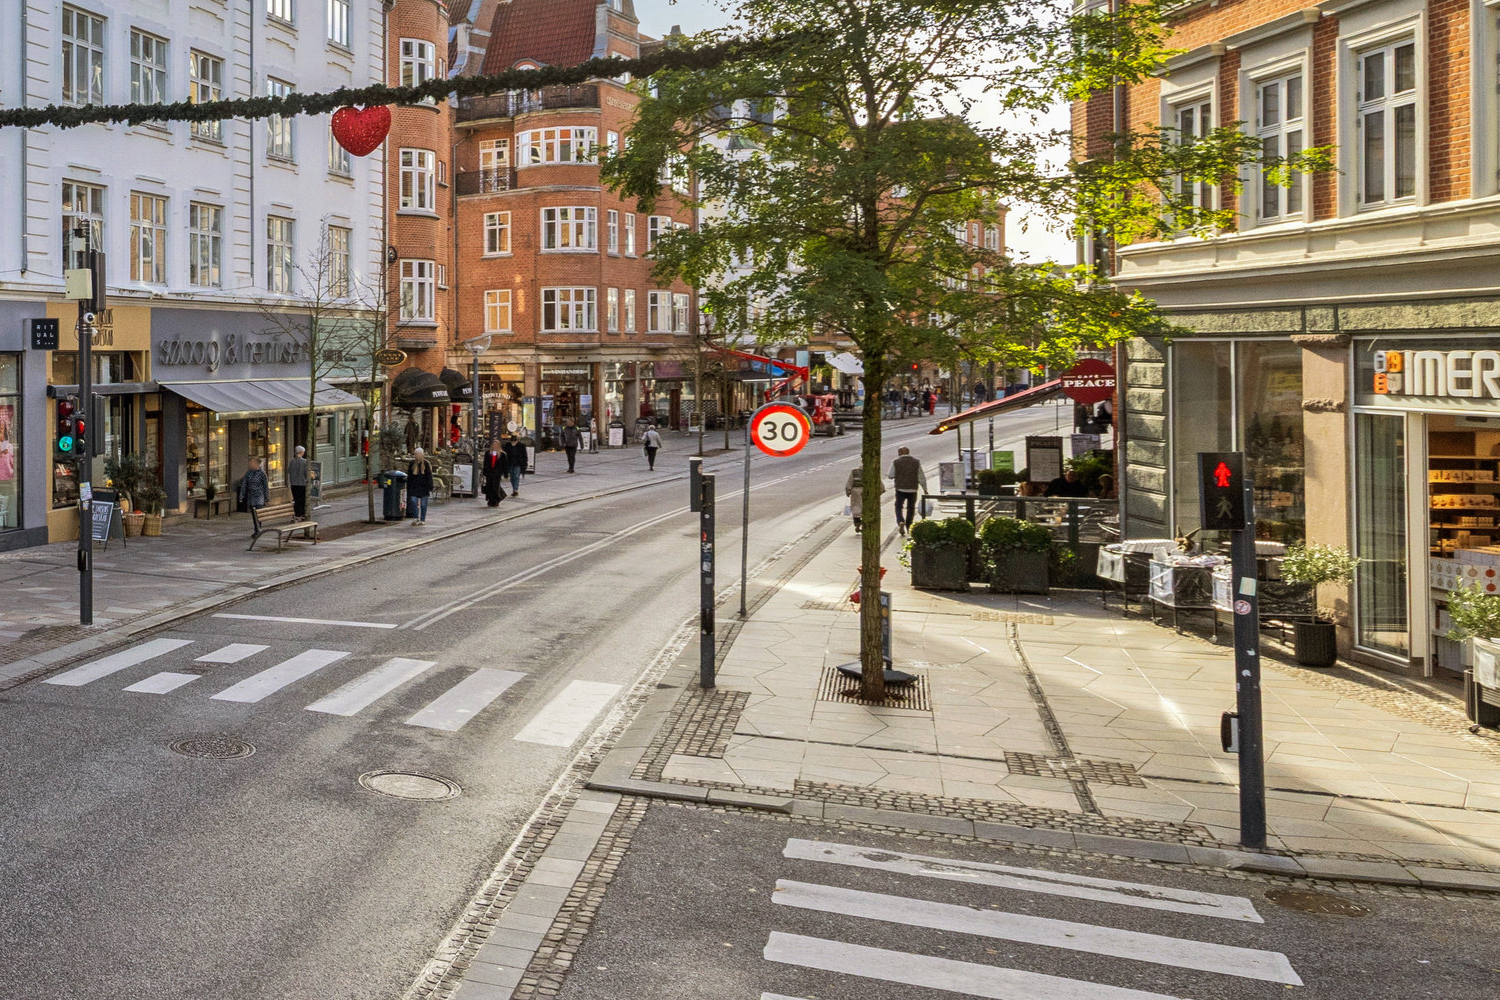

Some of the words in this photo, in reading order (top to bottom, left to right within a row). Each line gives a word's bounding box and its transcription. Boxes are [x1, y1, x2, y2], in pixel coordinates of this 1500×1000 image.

[224, 333, 238, 365] &
[1063, 379, 1116, 388] PEACE
[762, 421, 798, 442] 30
